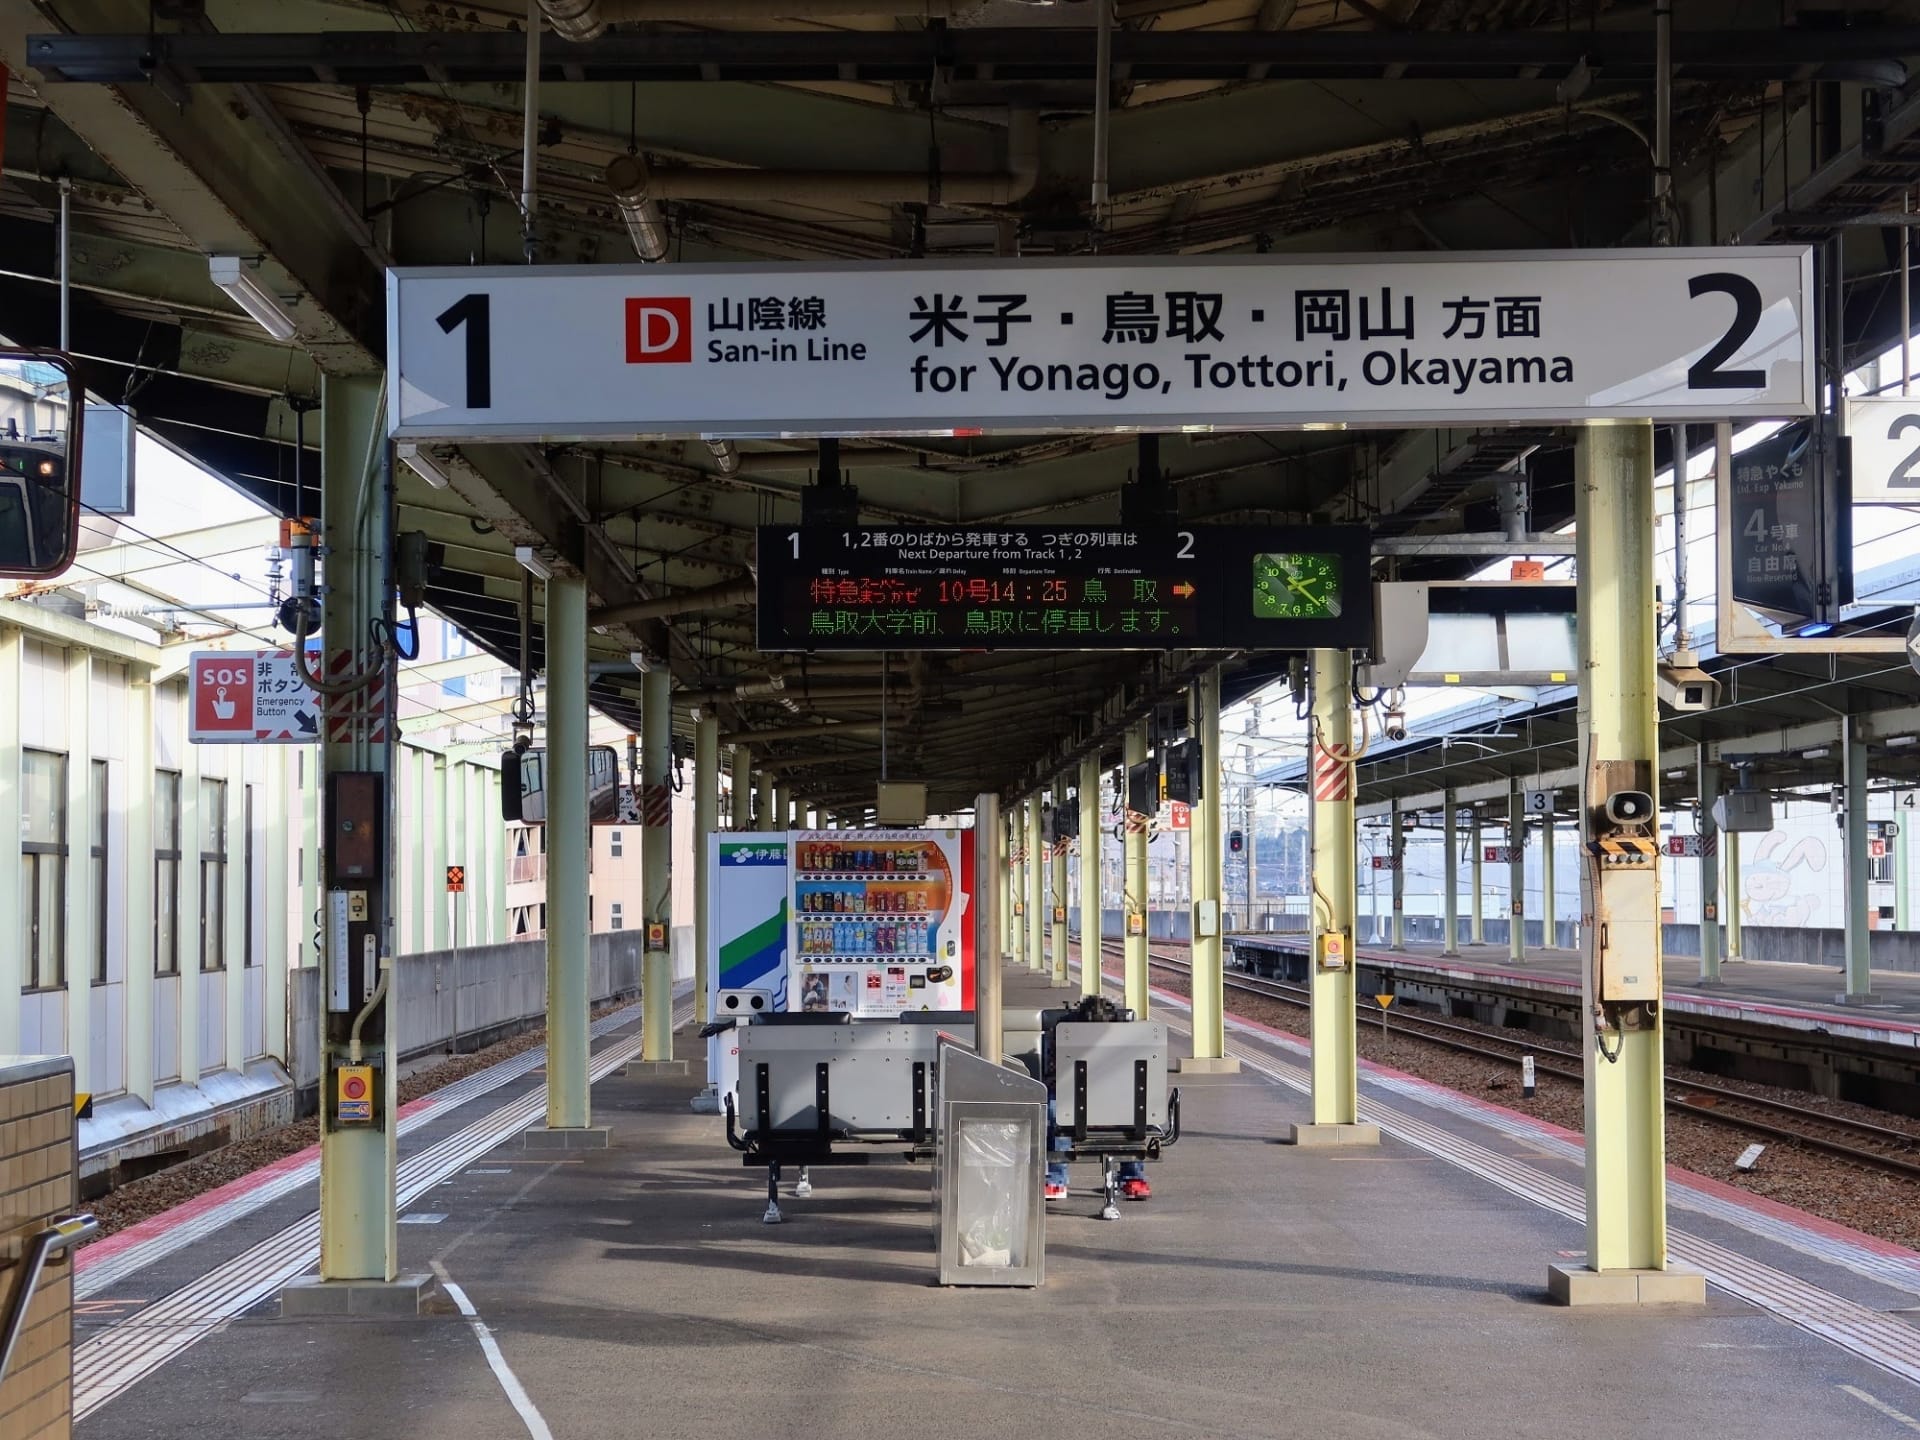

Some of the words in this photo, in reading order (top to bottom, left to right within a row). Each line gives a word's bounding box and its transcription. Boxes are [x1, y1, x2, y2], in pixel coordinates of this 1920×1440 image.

[707, 296, 827, 331] 山陰線
[1441, 295, 1543, 341] 方面
[638, 306, 680, 353] D
[1686, 272, 1767, 391] 2
[435, 293, 491, 409] 1
[707, 337, 800, 363] San-in
[807, 336, 867, 362] Line
[910, 356, 976, 393] for
[988, 355, 1171, 400] Yonago,
[1184, 349, 1348, 392] Tottori,
[1361, 346, 1574, 395] Okayama
[1886, 413, 1920, 489] 2
[786, 531, 800, 559] 1
[1041, 532, 1139, 547] つぎの列車は
[1175, 531, 1196, 559] 2
[898, 549, 928, 560] Next
[929, 549, 991, 563] Departure
[992, 549, 1022, 560] from
[1024, 548, 1056, 559] Track
[1291, 556, 1303, 565] 12
[1267, 567, 1279, 577] 10
[1280, 560, 1289, 569] 11
[1318, 566, 1327, 576] 2
[1260, 581, 1269, 590] 9
[1325, 581, 1333, 590] 3
[1267, 595, 1276, 604] 8
[1318, 595, 1327, 604] 4
[1280, 603, 1288, 612] 7
[1292, 605, 1301, 614] 6
[1305, 603, 1313, 612] 5
[202, 668, 248, 686] SOS
[257, 680, 305, 694] ボタン
[256, 697, 305, 707] Emergency
[256, 706, 287, 717] Button
[1533, 793, 1546, 810] 3
[1903, 793, 1916, 809] 4
